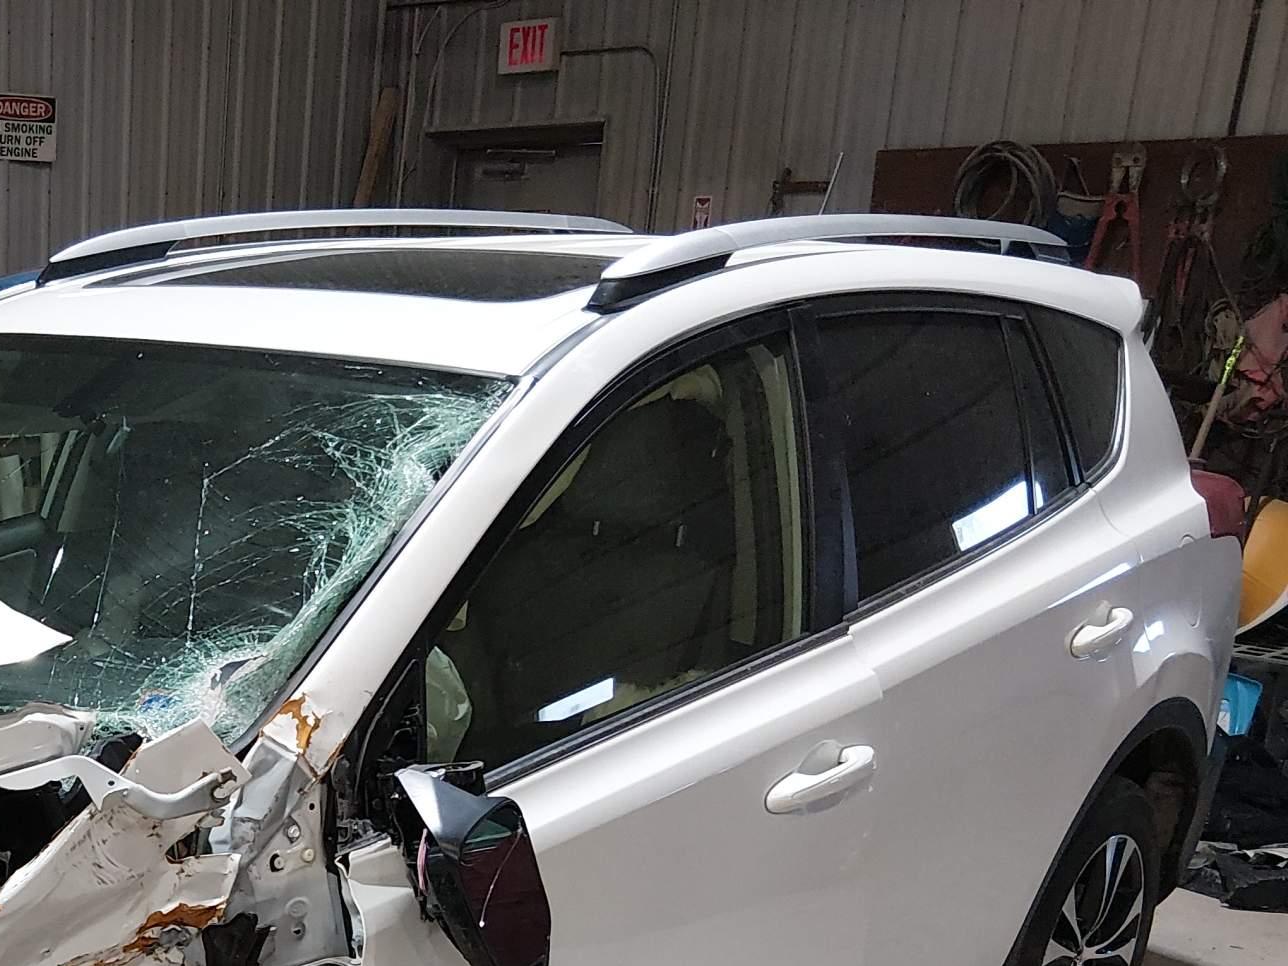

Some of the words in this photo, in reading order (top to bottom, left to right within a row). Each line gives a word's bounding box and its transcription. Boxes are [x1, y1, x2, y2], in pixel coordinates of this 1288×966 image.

[508, 24, 549, 66] EXIT
[5, 123, 53, 135] SMOKING
[25, 136, 46, 147] OFF
[0, 146, 38, 159] ENGINE
